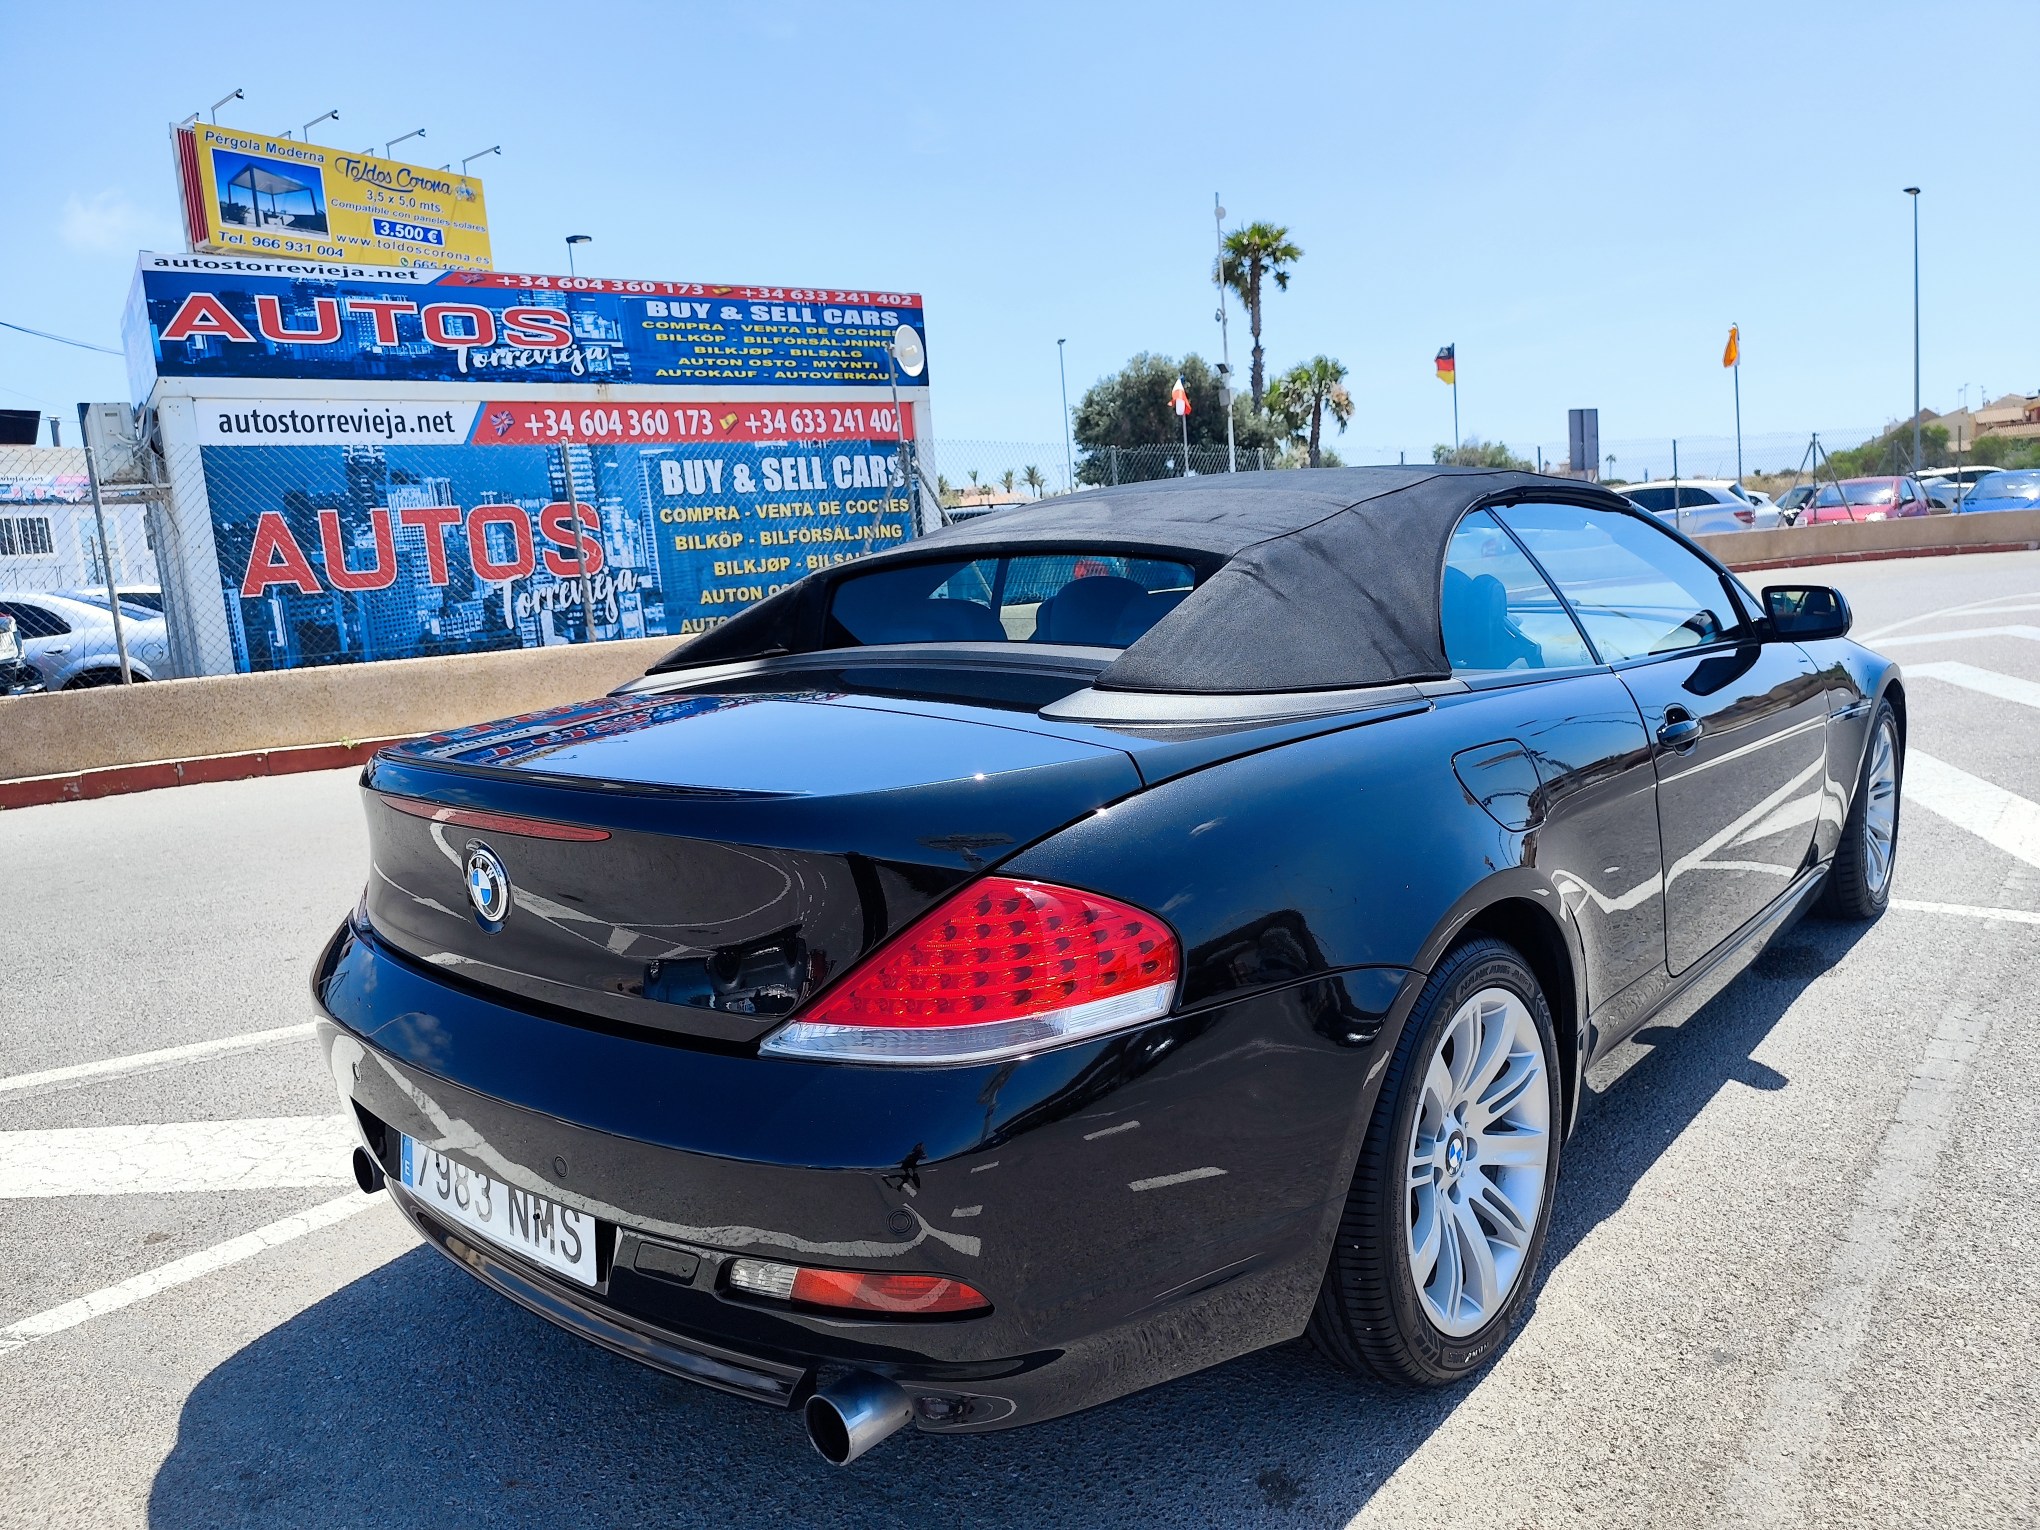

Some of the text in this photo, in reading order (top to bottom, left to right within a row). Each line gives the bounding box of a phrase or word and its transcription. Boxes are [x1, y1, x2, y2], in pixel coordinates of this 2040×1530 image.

[205, 131, 325, 163] Pérgola Moderna
[335, 157, 452, 195] Toldos Corona
[366, 190, 444, 213] 3,5 x 5,0 mts.
[331, 198, 487, 233] Compatible con paneles solares
[218, 231, 344, 258] Tel. 966 931 004
[380, 222, 438, 243] 3.500 €
[336, 234, 490, 265] www.toldoscorona.es
[154, 258, 420, 280] autostorrevieja.net
[496, 275, 705, 295] +34 604 360 173
[740, 287, 912, 306] +34 633 241 402
[159, 291, 573, 350] AUTOS
[646, 300, 899, 327] BUY & SELL CARS
[642, 321, 724, 331] COMPRA
[741, 324, 800, 333] VENTA
[806, 326, 828, 335] DE
[834, 328, 897, 337] COCHE
[655, 333, 726, 343] BILKÖP
[446, 343, 609, 376] Torrevieja
[678, 357, 743, 366] AUTON
[748, 359, 797, 367] OSTO
[812, 360, 878, 369] MYYNTI
[790, 349, 862, 358] BILSALG
[655, 369, 757, 378] AUTOKAUF
[218, 408, 456, 439] autostorrevieja.net
[524, 408, 714, 437] +34 604 360 173
[744, 408, 898, 434] +34 633 241 402
[660, 455, 905, 496] BUY & SELL CARS
[660, 505, 740, 523] COMPRA
[755, 502, 814, 519] VENTA
[819, 501, 841, 516] DE
[240, 502, 604, 598] AUTOS
[675, 531, 743, 551] BILKÖP
[714, 557, 791, 576] BILKJØP
[493, 564, 639, 630] Torrevieja
[700, 586, 763, 605] AUTON
[508, 1185, 582, 1264] NMS
